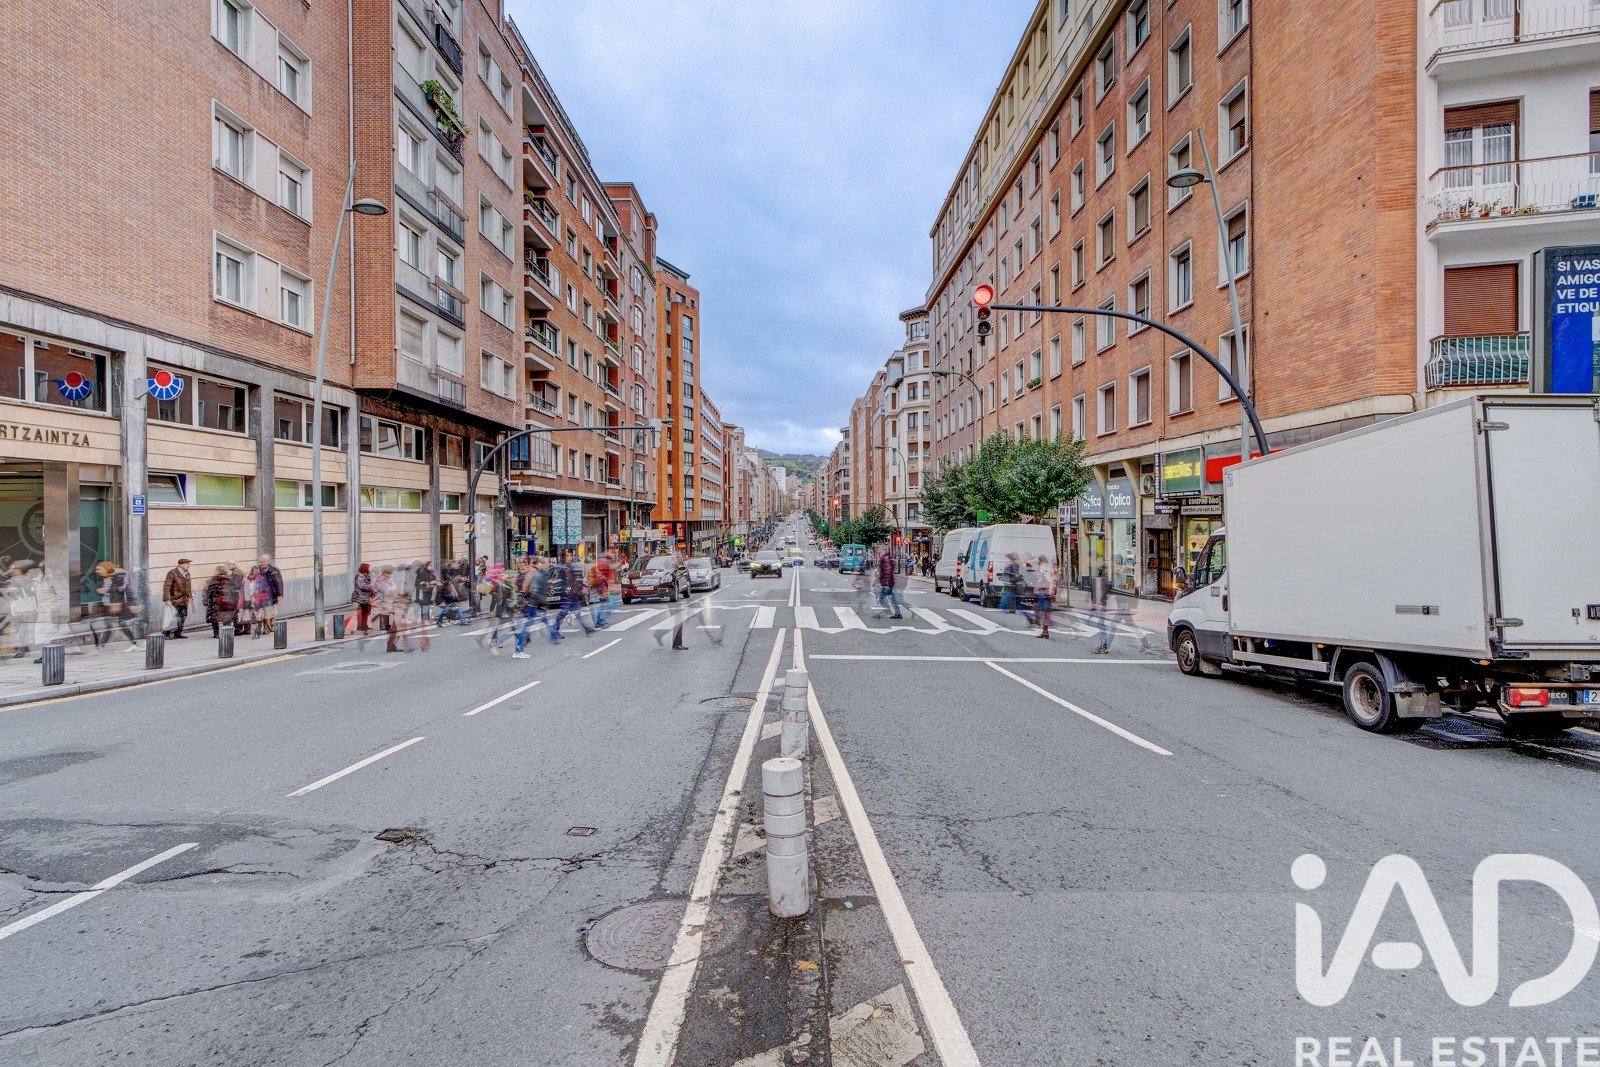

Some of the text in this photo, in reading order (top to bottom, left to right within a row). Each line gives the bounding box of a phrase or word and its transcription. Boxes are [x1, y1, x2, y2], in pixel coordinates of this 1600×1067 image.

[1557, 260, 1600, 271] SI VAS
[1557, 288, 1598, 299] VE DE
[1557, 302, 1600, 313] ETIQU
[1109, 491, 1131, 509] Óptica
[1592, 692, 1598, 702] 2
